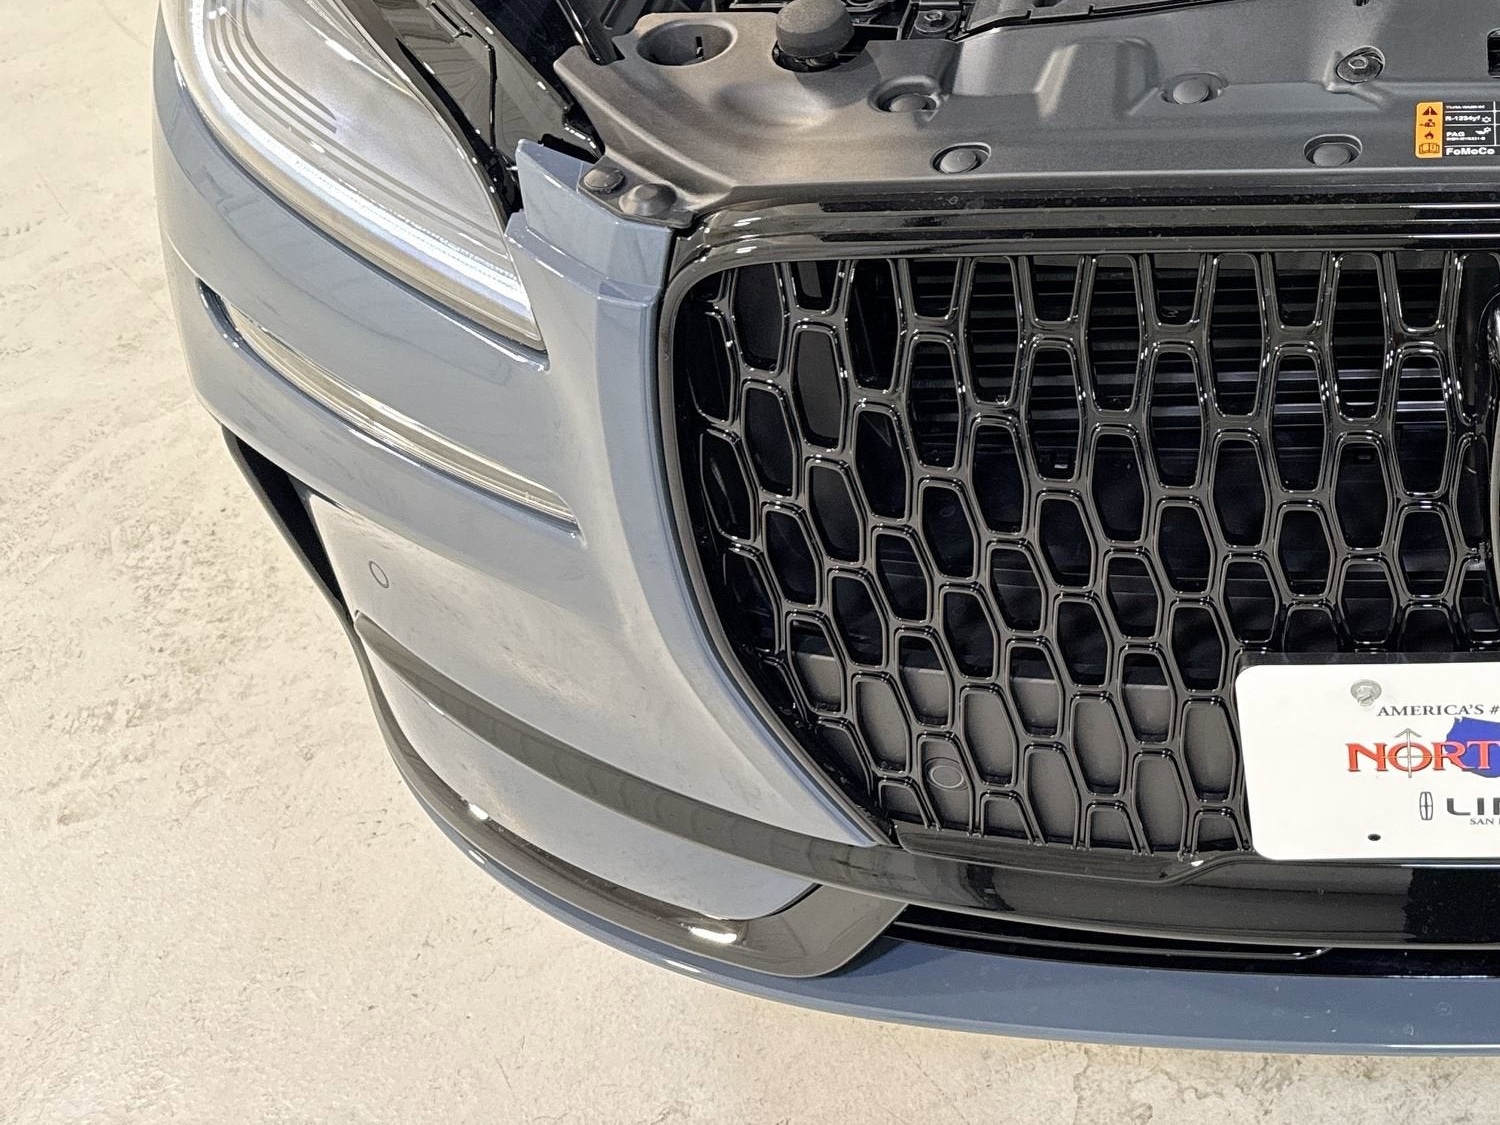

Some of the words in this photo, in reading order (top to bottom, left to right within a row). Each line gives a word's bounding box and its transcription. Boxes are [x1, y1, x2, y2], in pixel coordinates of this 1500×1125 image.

[1445, 147, 1495, 155] FoMoCo
[1376, 703, 1485, 717] AMERICA'S
[1469, 817, 1495, 825] SAN
